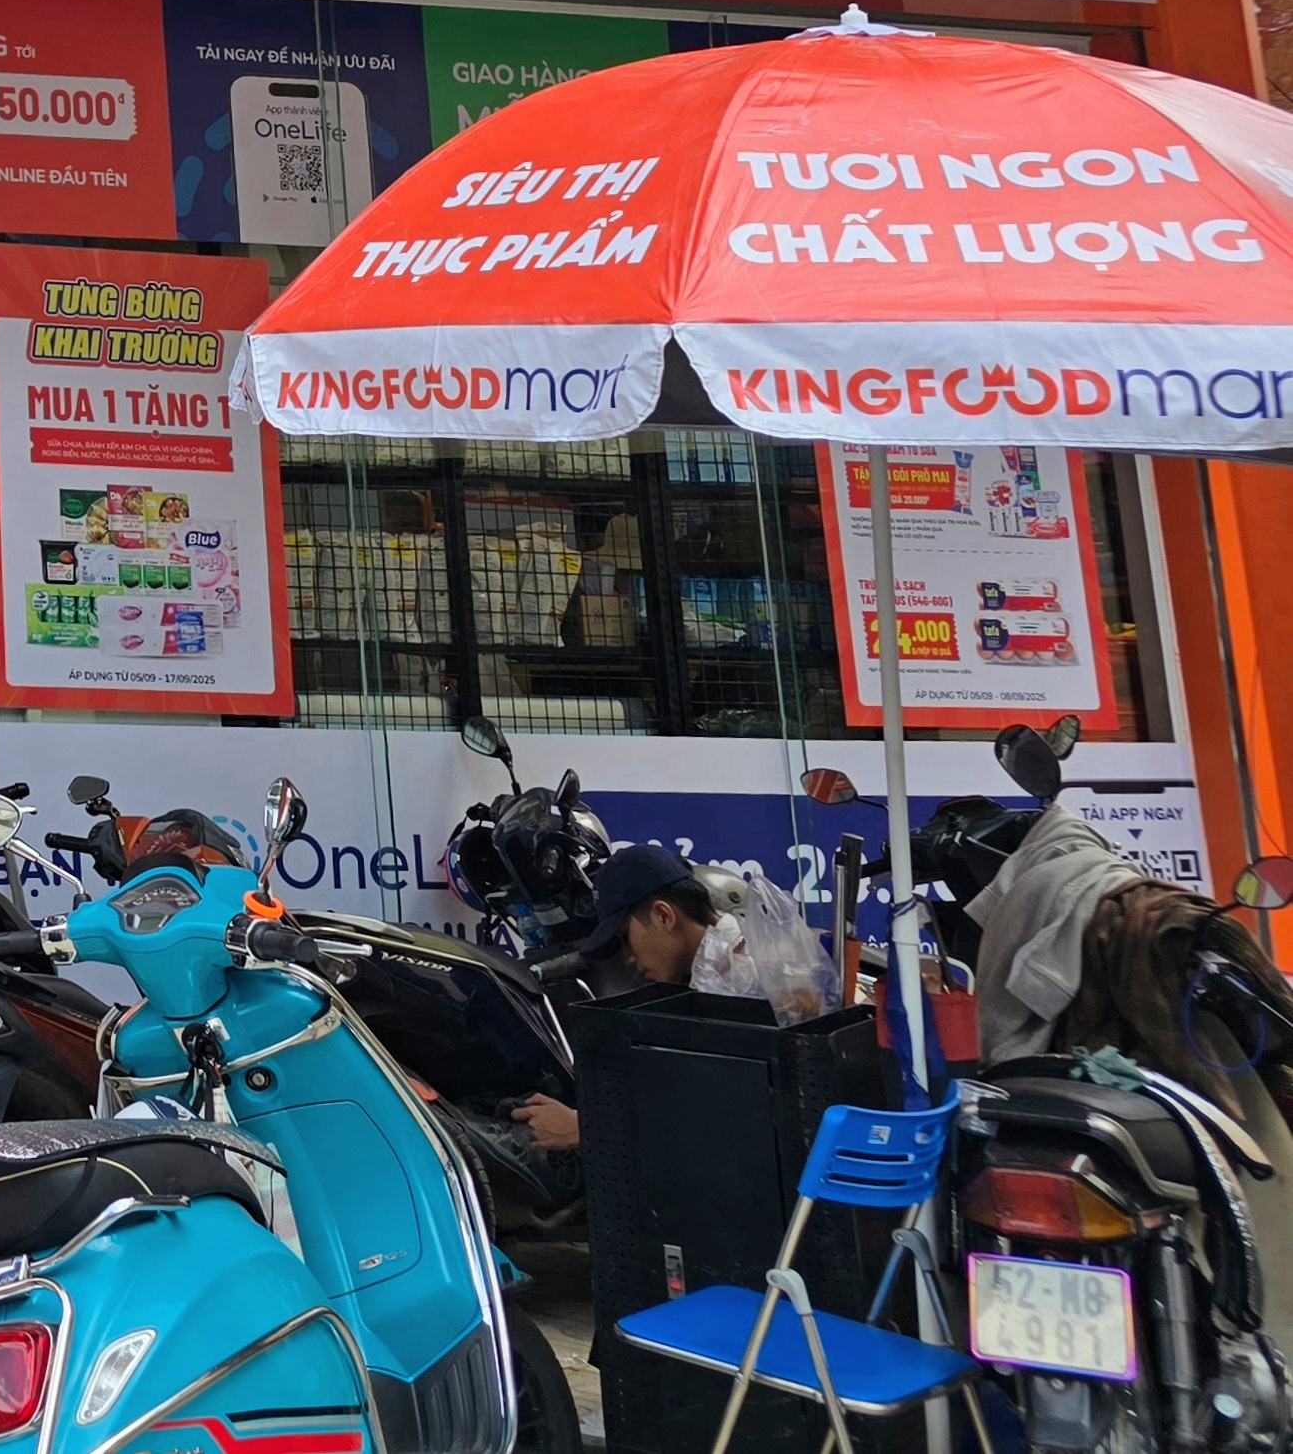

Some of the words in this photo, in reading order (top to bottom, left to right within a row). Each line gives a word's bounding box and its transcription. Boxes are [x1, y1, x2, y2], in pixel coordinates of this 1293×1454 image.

[14, 44, 36, 59] TỚI
[196, 42, 220, 61] TẢI
[224, 47, 265, 64] NGAY
[268, 45, 289, 65] ĐỂ
[344, 53, 366, 70] ƯU
[369, 53, 396, 71] ĐÃI
[452, 61, 514, 86] GIAO
[265, 104, 283, 116] App
[254, 118, 347, 143] OneLife
[49, 164, 87, 186] ĐẦU
[90, 168, 128, 188] TIÊN
[736, 151, 924, 191] TƯƠI
[939, 144, 1202, 190] NGON
[441, 160, 566, 208] SIÊU
[562, 156, 661, 202] THỊ
[352, 233, 489, 283] THỰC
[479, 209, 659, 272] PHẨM
[728, 208, 933, 264] CHẤT
[953, 217, 1266, 272] LƯỢNG
[45, 281, 118, 316] TƯNG
[125, 284, 203, 323] BỪNG
[33, 326, 100, 361] KHAI
[107, 330, 218, 368] TRƯƠNG
[276, 352, 629, 413] KINGFOODmart
[724, 361, 1293, 419] KINGFOODmar
[27, 385, 95, 423] MUA
[103, 389, 116, 424] 1
[126, 384, 210, 438] TẶNG
[217, 396, 231, 430] 1
[894, 468, 909, 482] GÓI
[933, 471, 950, 484] MAI
[187, 532, 219, 547] Blue
[903, 580, 926, 595] SẠCH
[68, 667, 81, 681] ÁP
[83, 670, 113, 684] DỤNG
[115, 668, 128, 682] TỪ
[130, 672, 156, 683] 05/09
[165, 673, 216, 686] 17/09/2025
[915, 689, 928, 700] ÁP
[929, 691, 955, 702] DỤNG
[956, 689, 968, 700] TỪ
[970, 691, 993, 701] 05/09
[1080, 803, 1105, 821] TẢI
[1109, 807, 1139, 821] APP
[1143, 807, 1184, 821] NGAY
[275, 831, 452, 890] OneL
[381, 951, 453, 973] VISION
